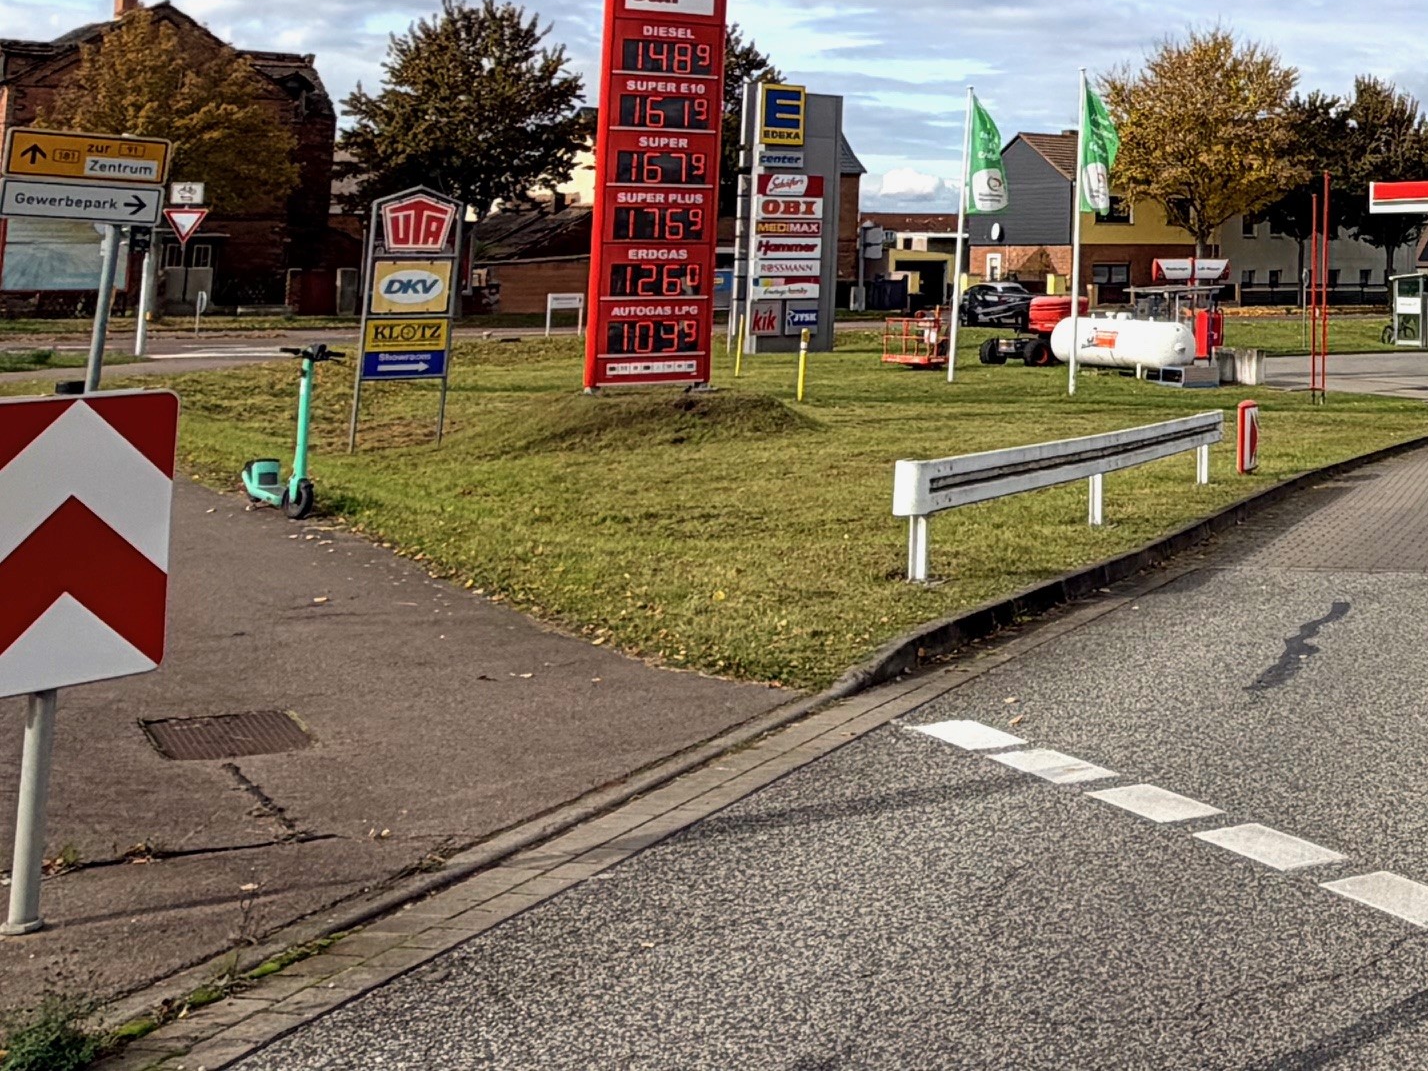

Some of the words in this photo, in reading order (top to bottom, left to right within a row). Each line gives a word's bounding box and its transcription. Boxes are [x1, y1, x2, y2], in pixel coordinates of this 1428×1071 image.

[643, 25, 695, 39] DIESEL
[626, 80, 677, 93] SUPER
[680, 83, 705, 95] E10
[87, 143, 111, 154] zur
[638, 136, 688, 148] SUPER
[760, 155, 801, 164] center
[89, 159, 153, 175] Zentrum
[15, 193, 118, 210] Gewerbepark
[617, 192, 665, 204] SUPER
[668, 193, 703, 204] PLUS
[762, 199, 817, 215] OBI
[389, 199, 450, 245] UTA
[757, 223, 818, 233] MEDIMAX
[628, 249, 688, 260] ERDGAS
[757, 240, 818, 256] Hammer
[760, 264, 813, 273] ROSSMANN
[383, 279, 439, 295] DKV
[611, 306, 672, 316] AUTOGAS
[675, 305, 699, 315] LPG
[793, 313, 817, 322] JYSK
[373, 324, 441, 341] KLOTZ
